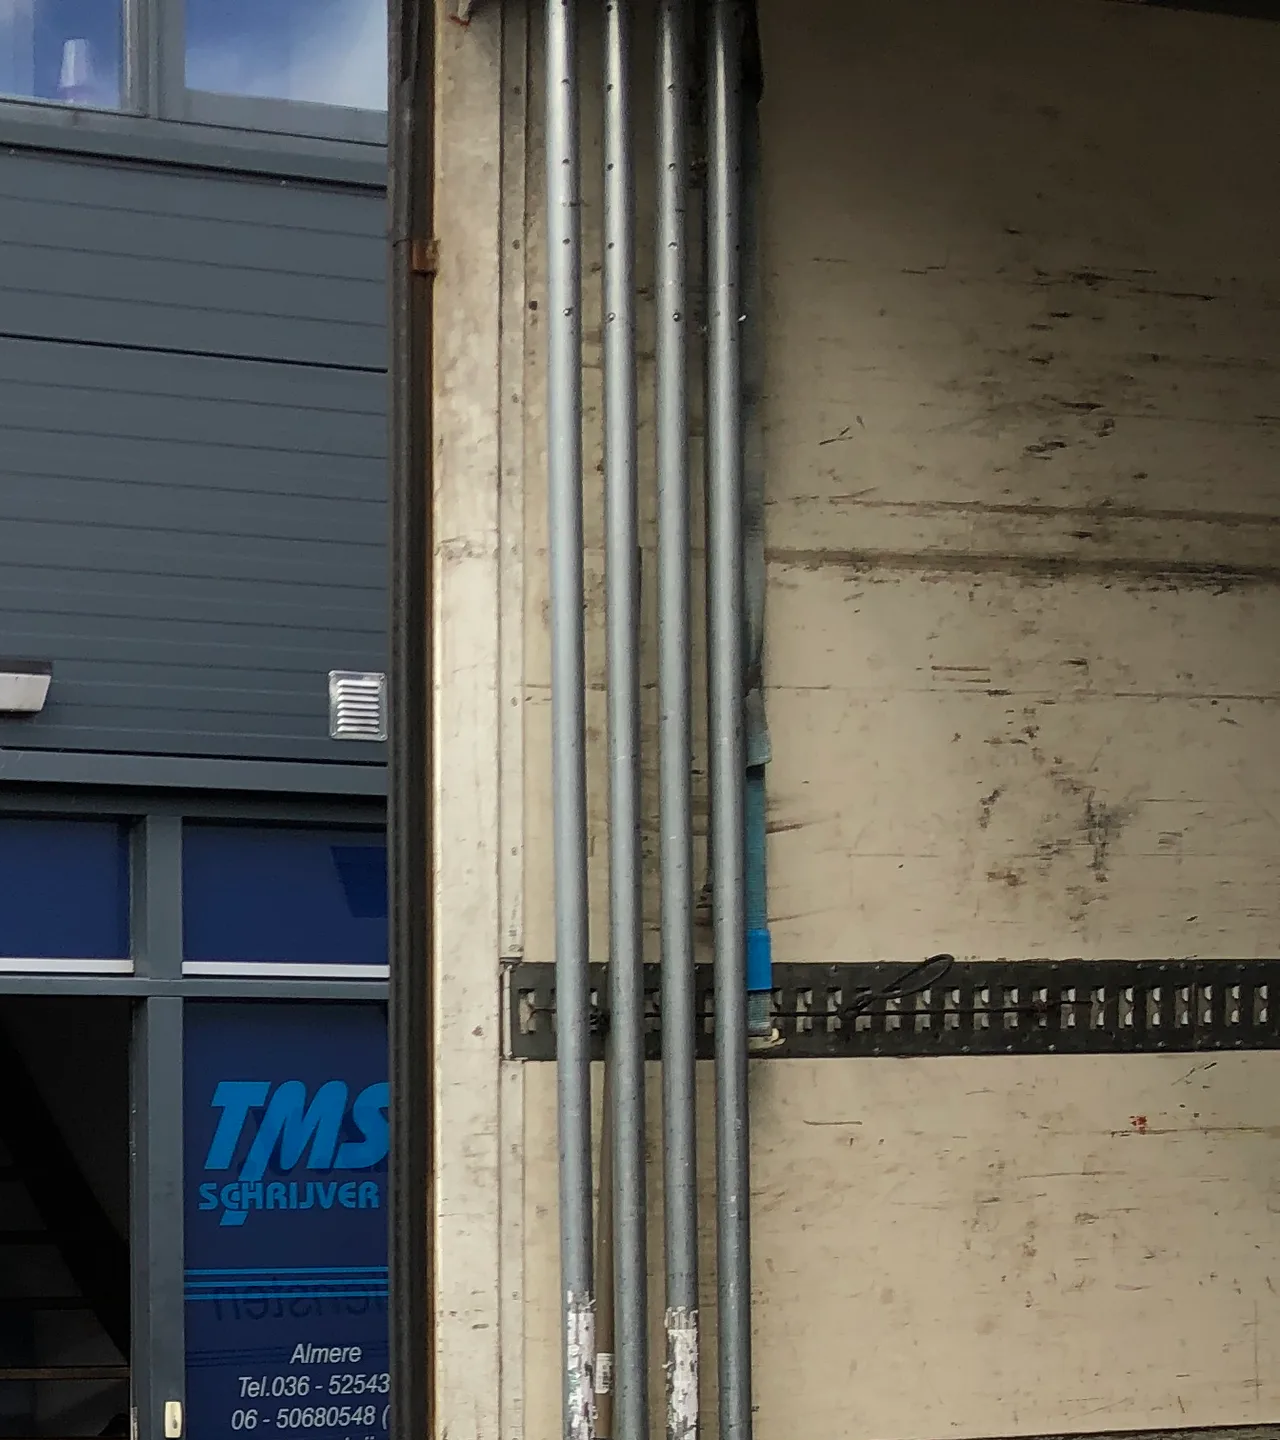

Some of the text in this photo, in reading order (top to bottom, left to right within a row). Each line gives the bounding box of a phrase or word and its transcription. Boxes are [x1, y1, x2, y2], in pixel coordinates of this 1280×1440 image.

[204, 1080, 389, 1180] TMS
[198, 1181, 380, 1212] SCHRIJVER
[290, 1343, 362, 1364] Almere
[239, 1376, 310, 1398] Tel.036
[328, 1373, 390, 1395] 52543
[231, 1409, 258, 1430] 06
[276, 1405, 376, 1429] 50680548
